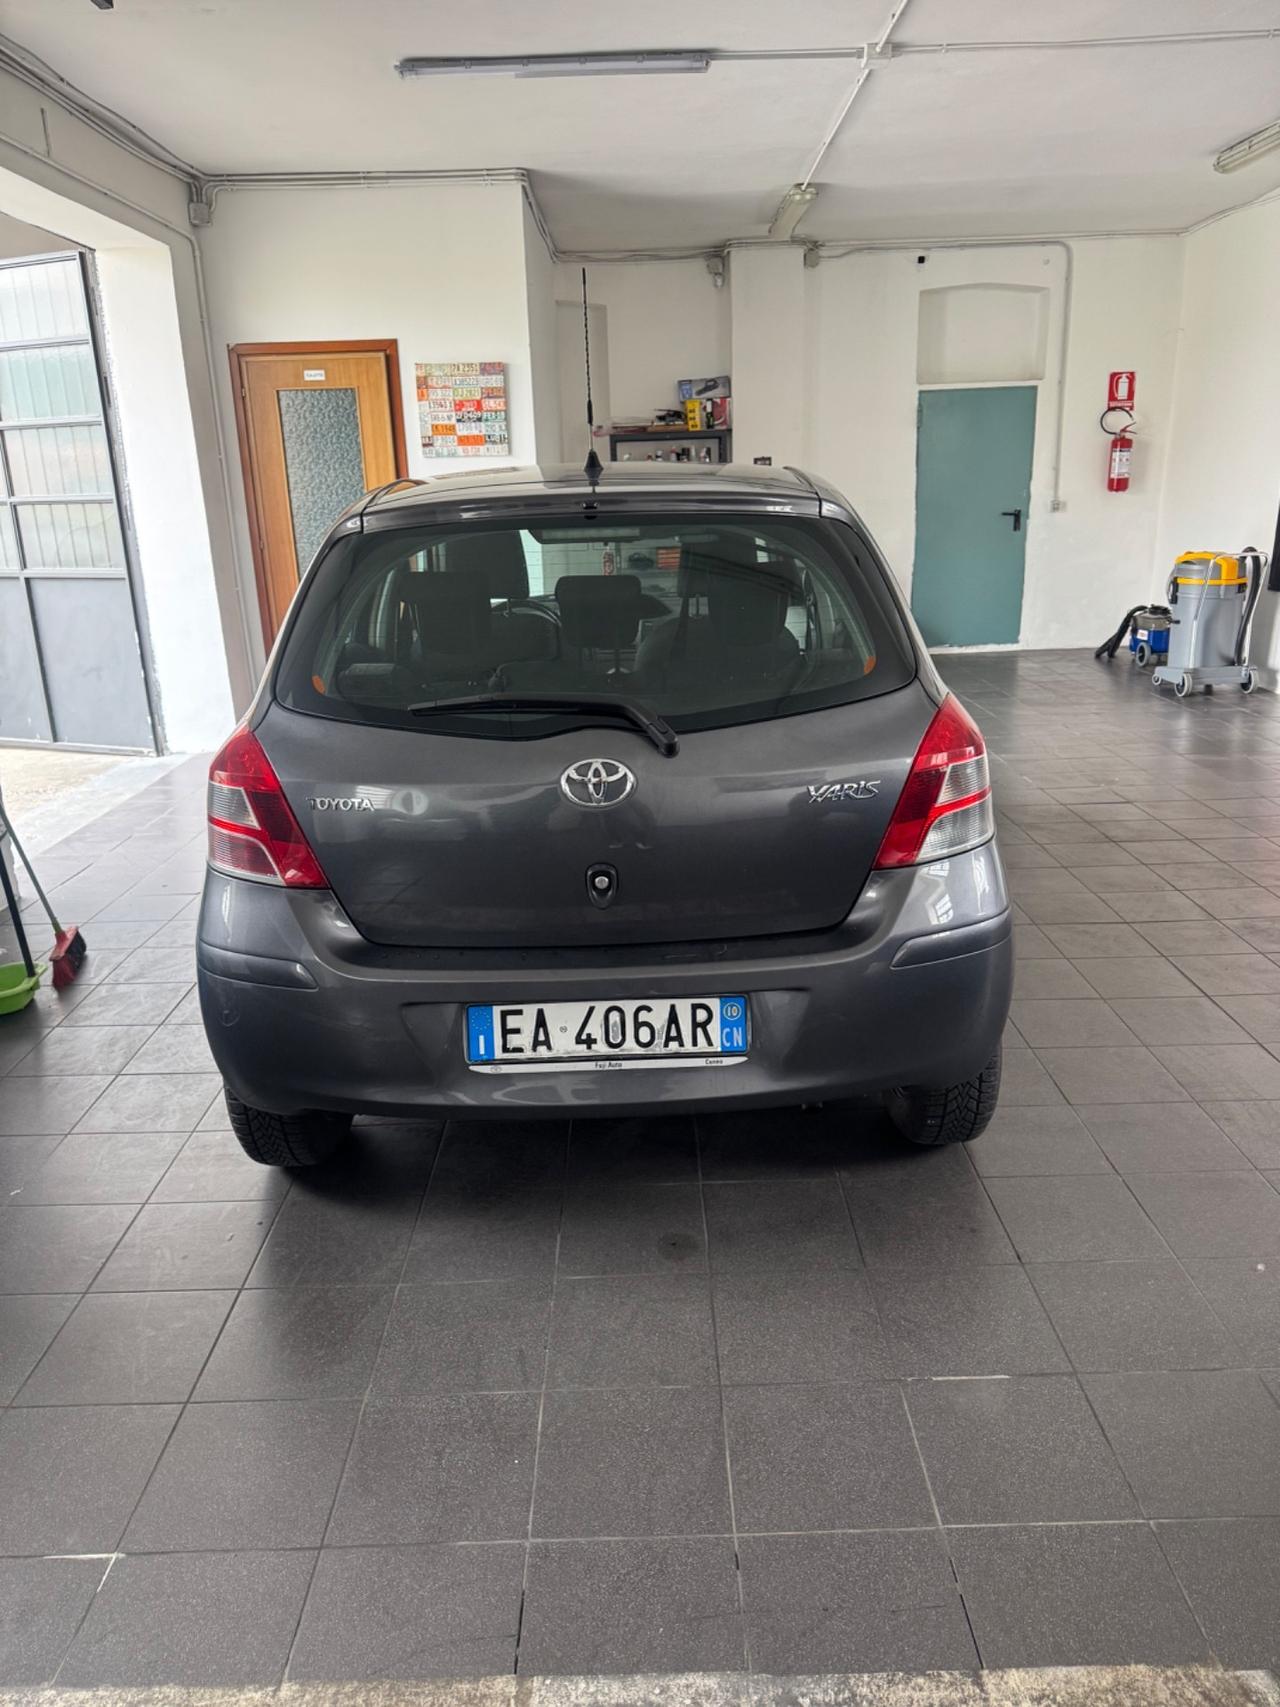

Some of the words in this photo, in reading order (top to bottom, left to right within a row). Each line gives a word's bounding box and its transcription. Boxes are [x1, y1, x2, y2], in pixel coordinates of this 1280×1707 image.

[807, 780, 881, 803] YARIS
[306, 797, 374, 811] TOYOTA
[500, 1007, 553, 1053] EA
[575, 1003, 714, 1050] 406AR
[722, 1027, 743, 1048] CN
